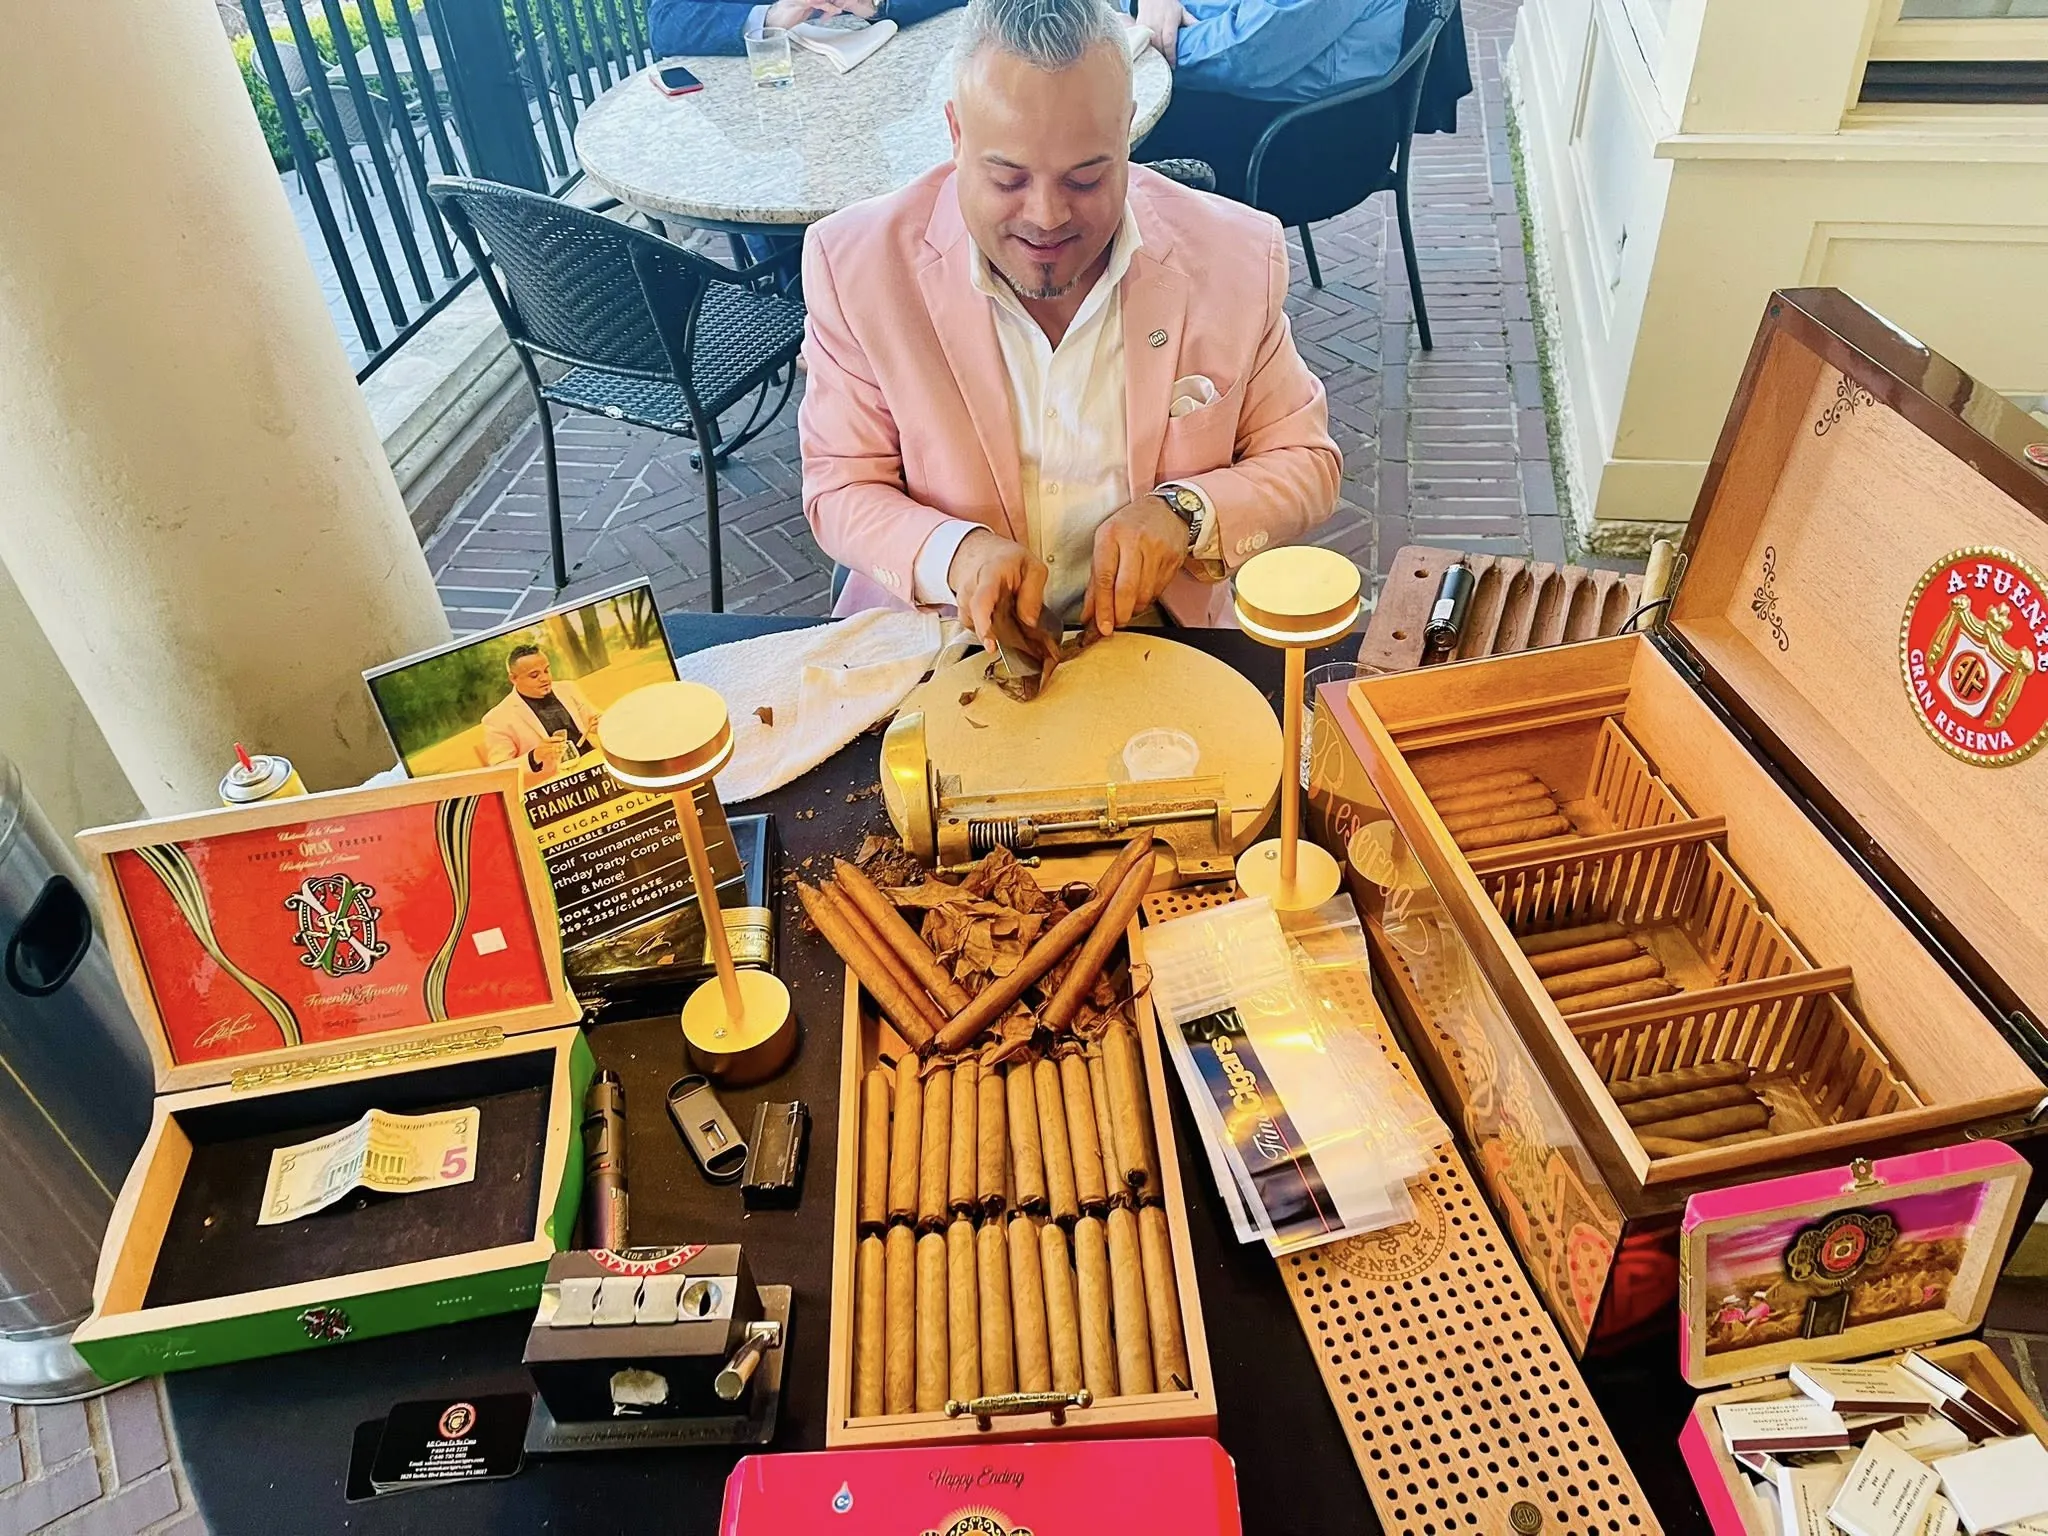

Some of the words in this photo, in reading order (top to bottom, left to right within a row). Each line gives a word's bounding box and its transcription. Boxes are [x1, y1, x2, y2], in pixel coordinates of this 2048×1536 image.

[1911, 649, 1936, 710] GRAN
[1934, 710, 2015, 751] RESERVA
[541, 772, 588, 796] VENUE
[528, 784, 600, 823] FRANKLIN
[563, 811, 609, 834] CIGAR
[548, 826, 604, 854] AVAILABLE
[606, 820, 627, 833] FOR
[631, 838, 660, 859] Corp
[550, 857, 576, 874] Golf
[581, 884, 590, 895] &
[592, 870, 625, 890] More!
[594, 890, 628, 911] YOUR
[632, 876, 664, 896] DATE
[1211, 1036, 1263, 1113] Cigars
[440, 1146, 467, 1180] 5
[593, 1250, 657, 1275] MAKAO
[928, 1467, 973, 1493] Happy
[976, 1465, 1025, 1489] Ending
